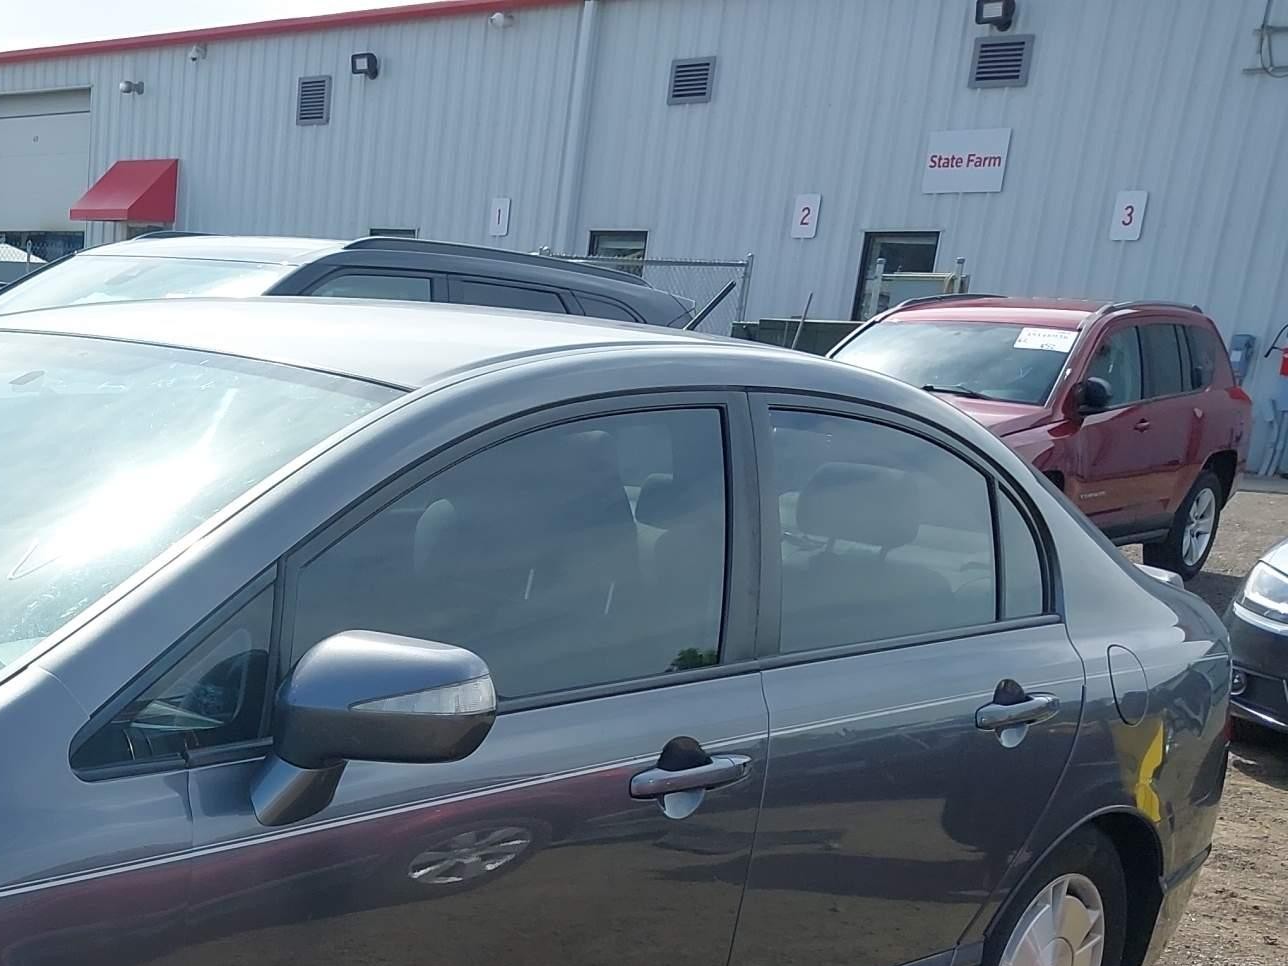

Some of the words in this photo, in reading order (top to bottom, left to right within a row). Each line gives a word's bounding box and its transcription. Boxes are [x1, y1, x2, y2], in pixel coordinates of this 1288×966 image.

[928, 154, 964, 169] State
[966, 153, 1002, 168] Farm
[799, 206, 811, 226] 2
[1122, 205, 1134, 226] 3
